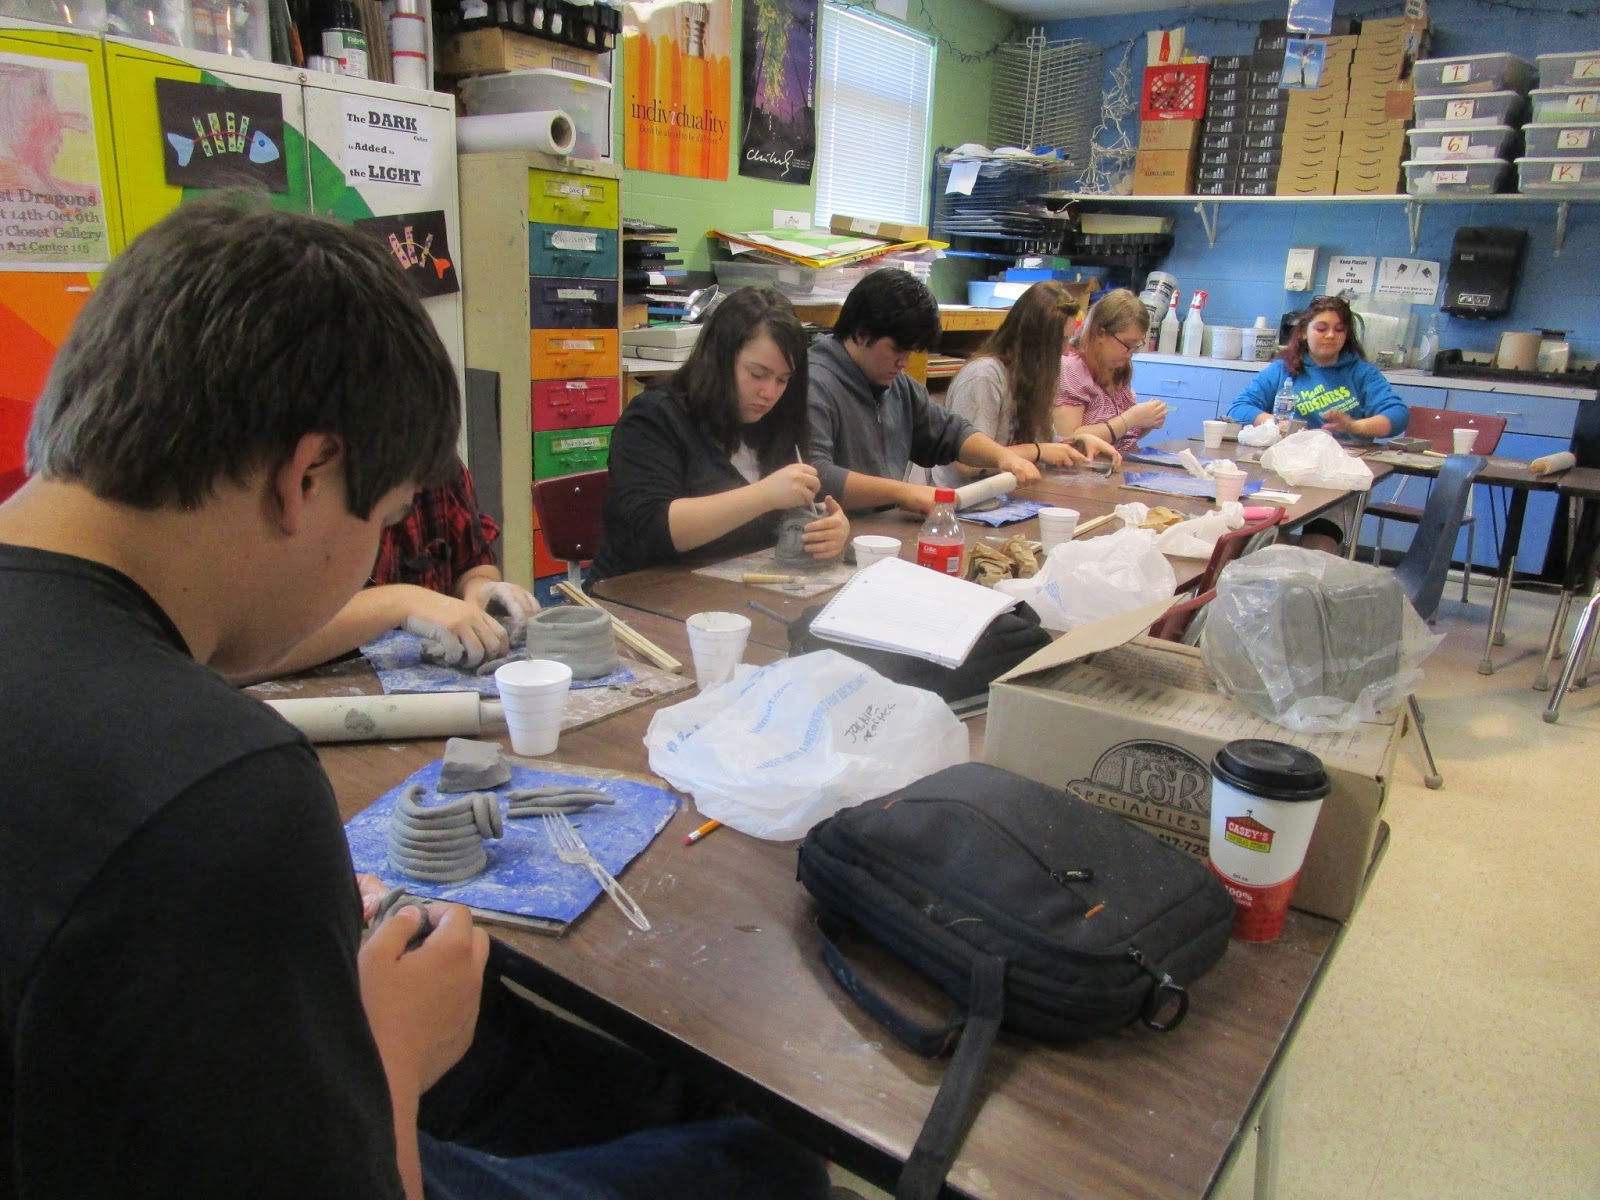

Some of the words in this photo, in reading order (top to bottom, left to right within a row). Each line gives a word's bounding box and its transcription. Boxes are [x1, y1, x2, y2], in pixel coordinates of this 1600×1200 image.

[346, 113, 366, 124] The
[368, 111, 418, 133] DARK
[631, 95, 727, 141] individuality
[354, 142, 388, 154] Added
[349, 168, 366, 177] the
[368, 165, 421, 183] LIGHT
[1559, 166, 1574, 180] K
[17, 188, 97, 207] Dragons
[75, 211, 99, 224] 9th
[5, 225, 50, 238] Closet
[53, 226, 102, 241] Gallery
[7, 241, 26, 252] Art
[29, 241, 68, 252] Center
[1296, 386, 1350, 416] BUSINESS
[1300, 384, 1325, 400] Mean
[1072, 786, 1201, 831] SPECIALTIES
[1228, 821, 1269, 841] CASEY'S
[1158, 833, 1210, 857] 17-725
